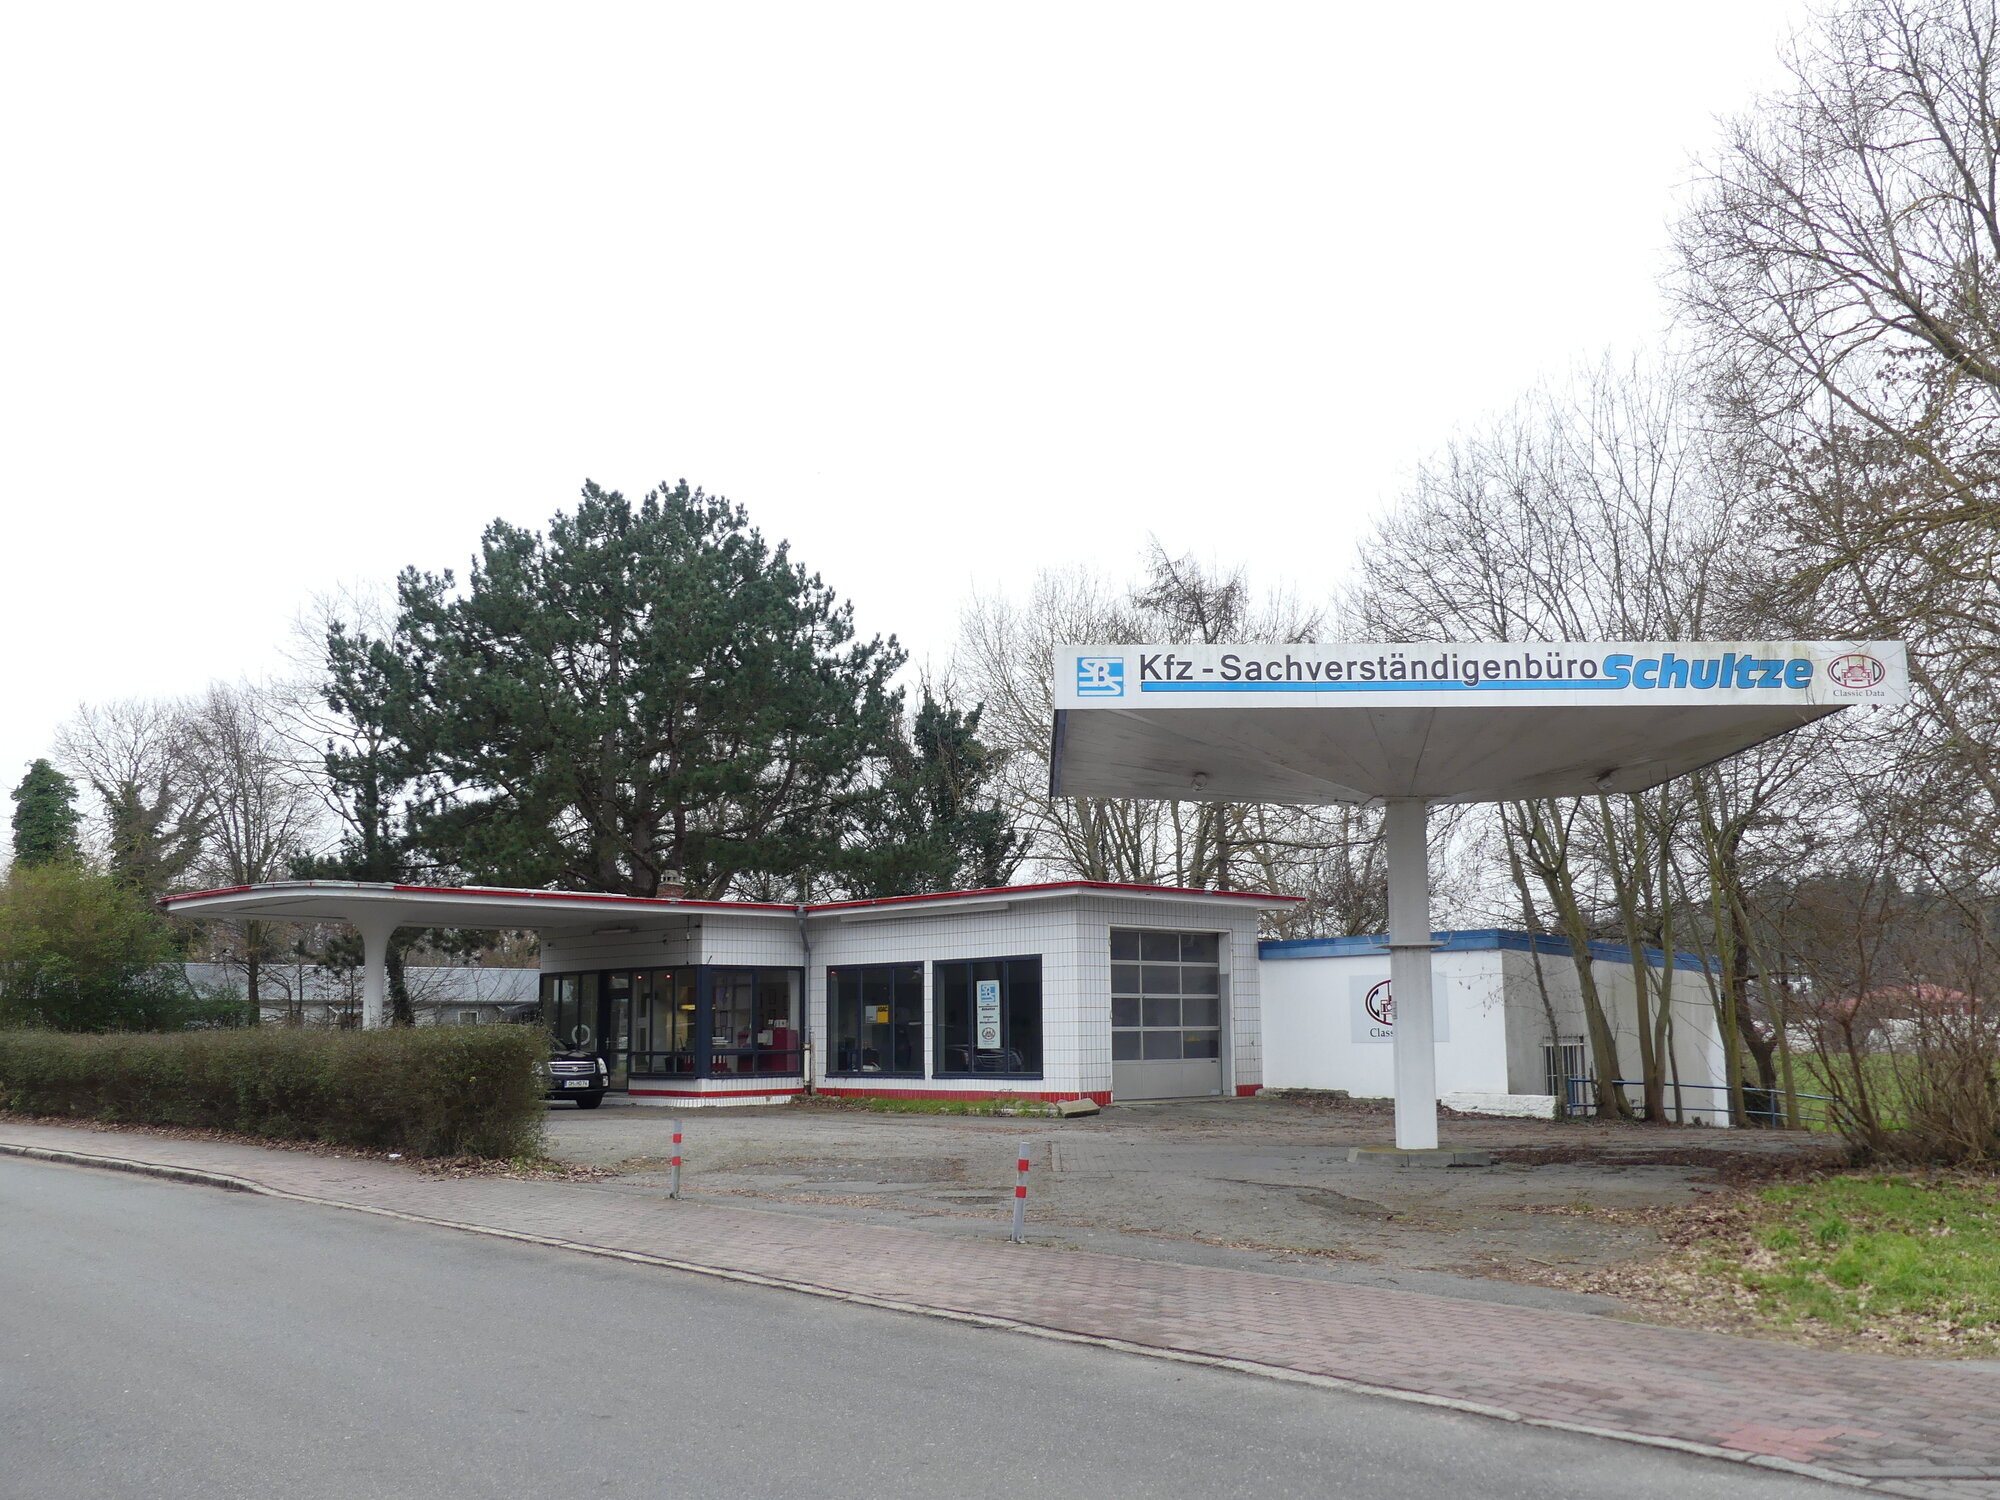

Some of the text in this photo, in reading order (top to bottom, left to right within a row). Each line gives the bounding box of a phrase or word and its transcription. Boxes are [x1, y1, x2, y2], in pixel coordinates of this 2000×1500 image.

[1603, 653, 1814, 690] Schultze
[1833, 689, 1885, 697] Classic Data
[1369, 1027, 1394, 1038] Class
